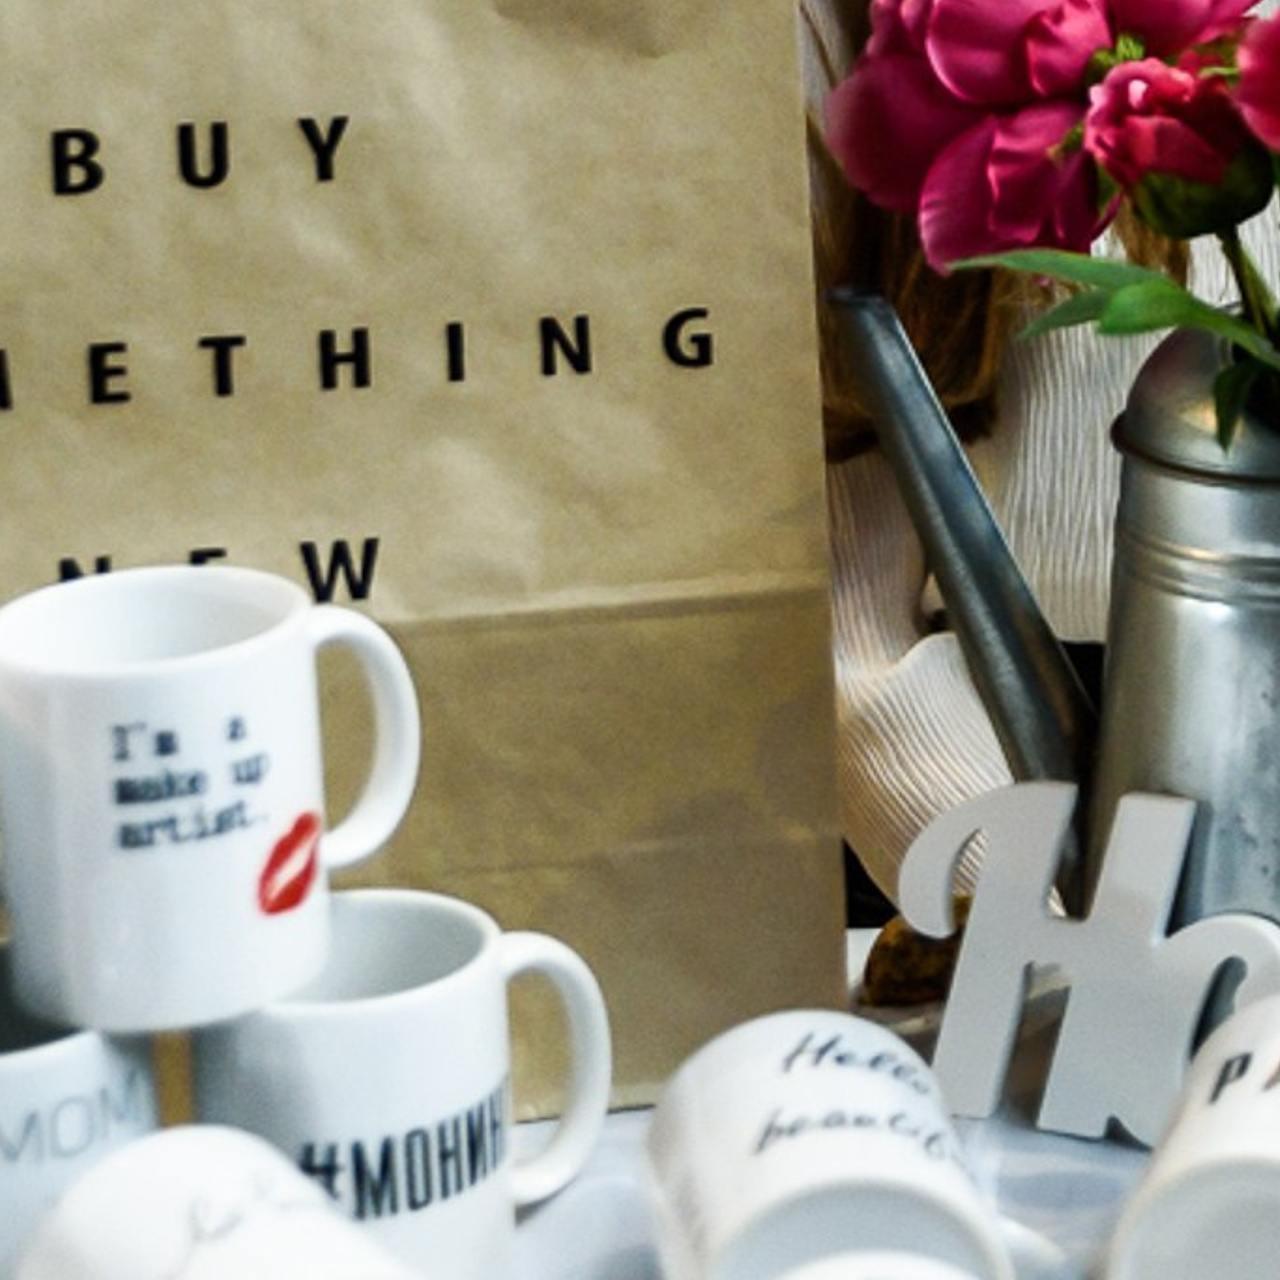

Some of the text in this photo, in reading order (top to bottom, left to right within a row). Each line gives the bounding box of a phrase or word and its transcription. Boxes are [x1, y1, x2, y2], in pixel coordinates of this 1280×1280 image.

[50, 116, 350, 196] BUY
[0, 308, 714, 411] ETHING
[115, 751, 270, 806] make up
